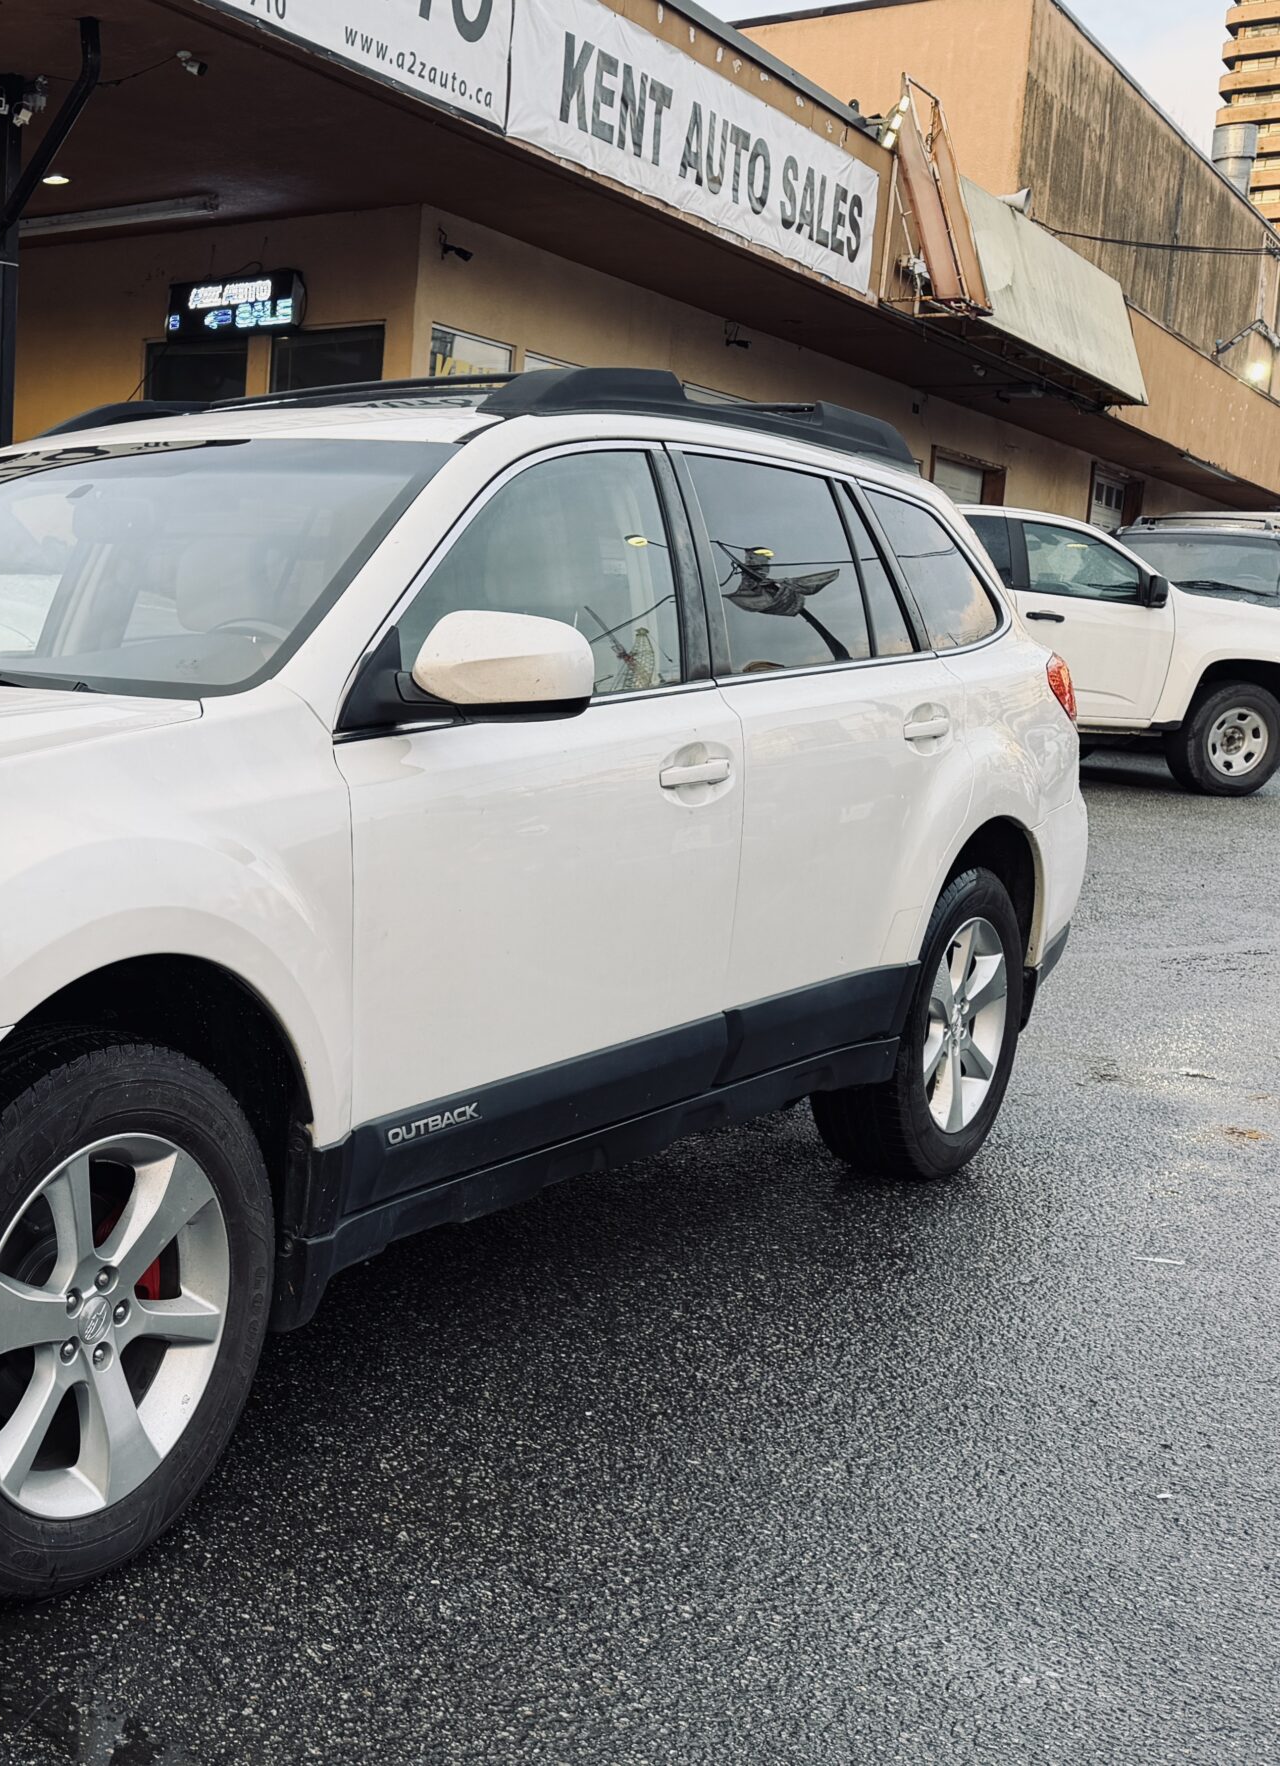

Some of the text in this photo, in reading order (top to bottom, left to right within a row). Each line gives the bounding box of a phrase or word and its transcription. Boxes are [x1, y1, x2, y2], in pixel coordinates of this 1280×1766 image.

[344, 25, 493, 108] www.a2zauto.ca
[559, 31, 863, 264] KENT AUTO SALES
[387, 1102, 480, 1146] OUTBACK
